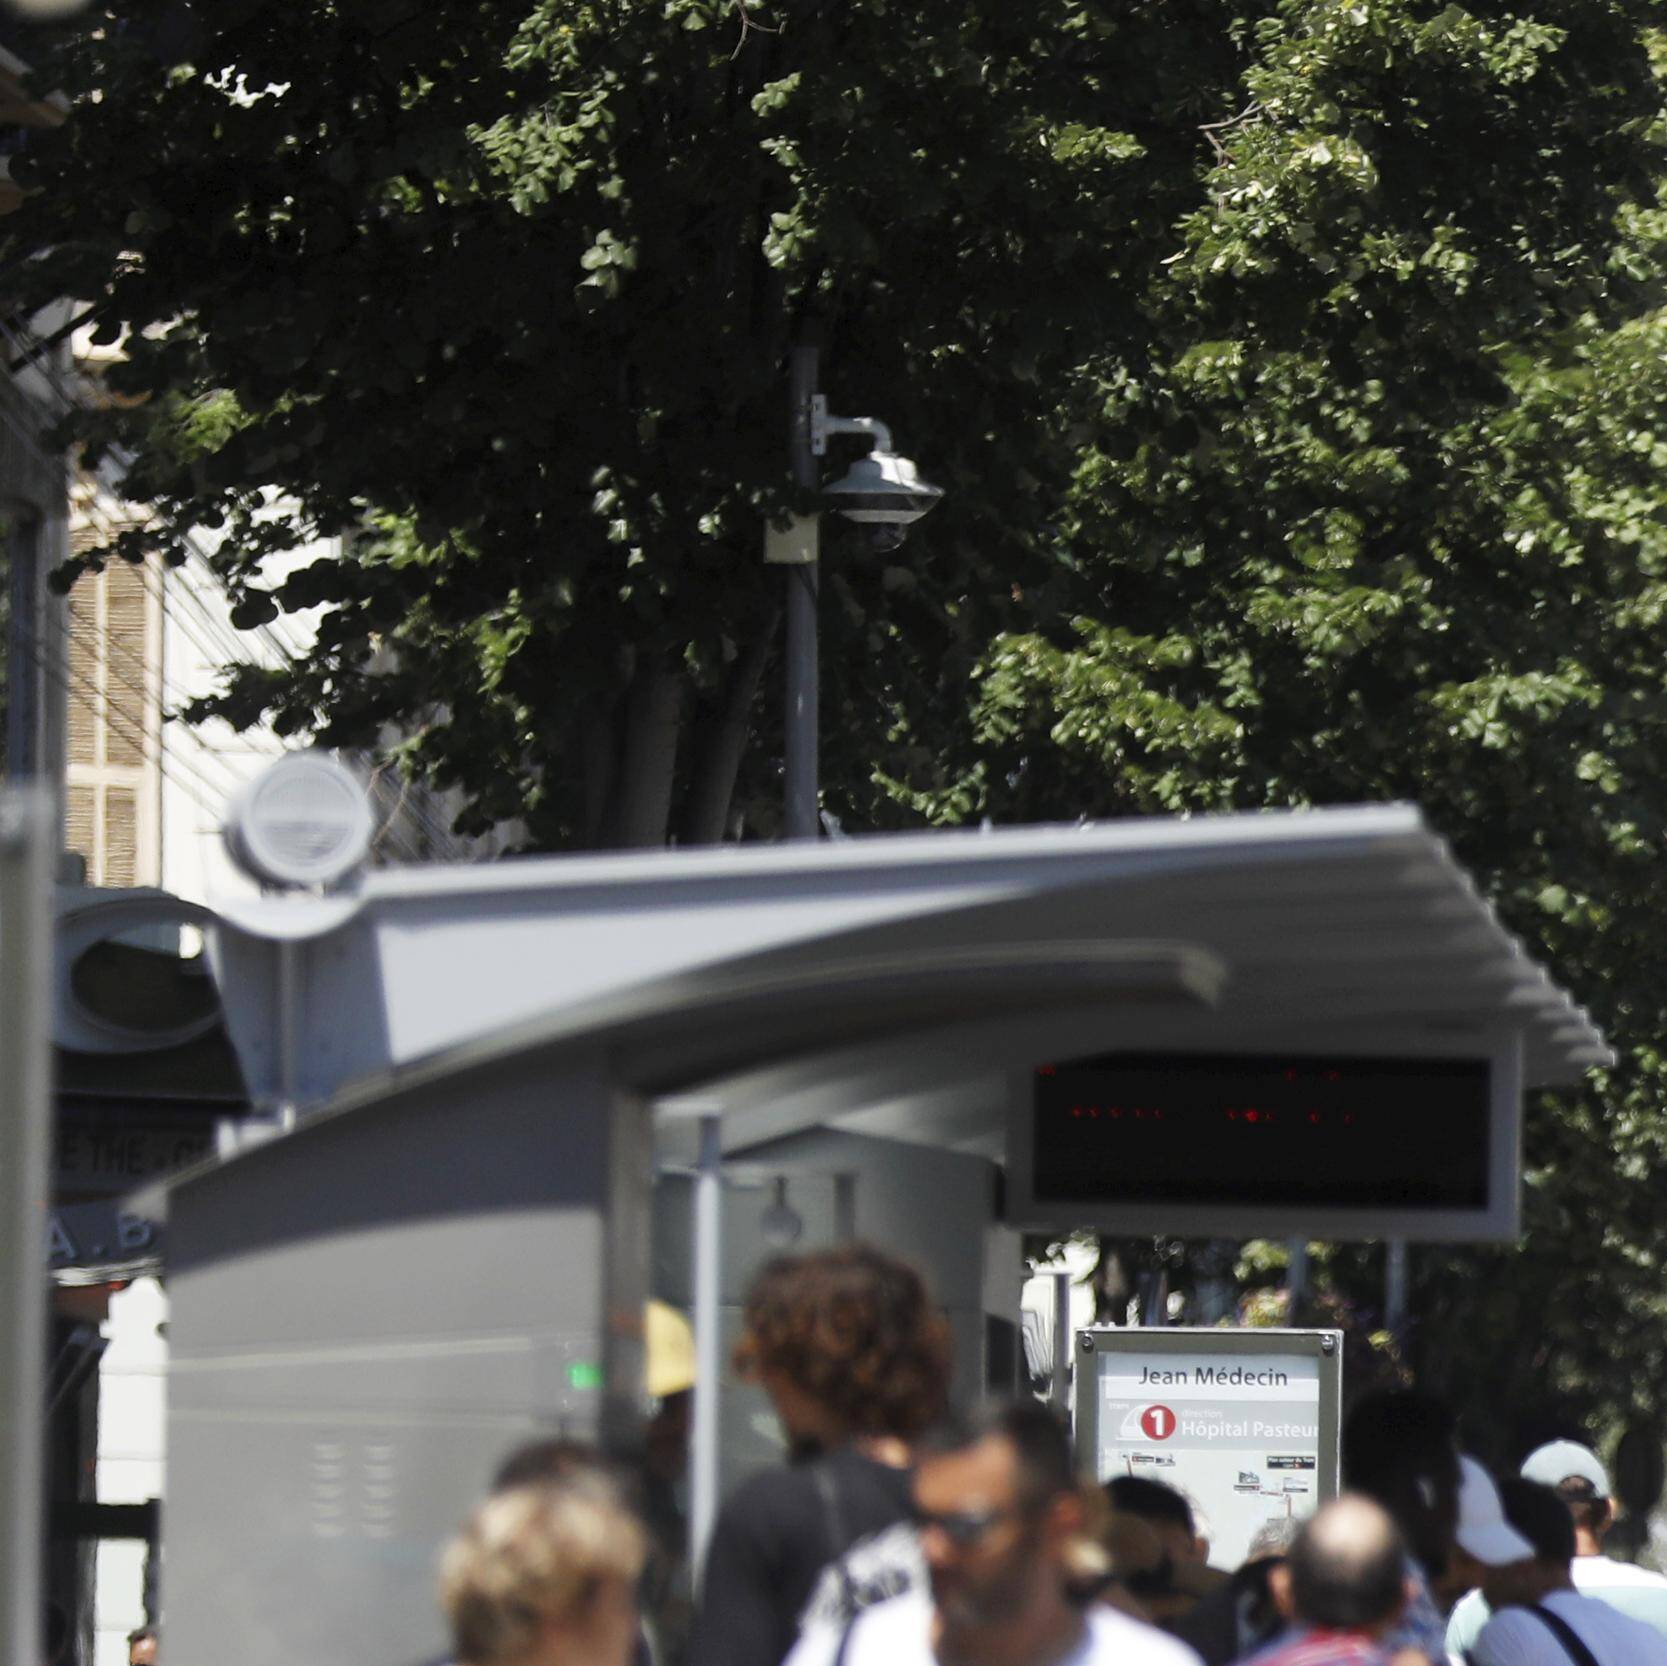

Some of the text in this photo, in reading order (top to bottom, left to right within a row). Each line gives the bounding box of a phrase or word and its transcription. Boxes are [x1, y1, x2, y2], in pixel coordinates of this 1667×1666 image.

[1138, 1366, 1288, 1386] Jean Médecin
[1149, 1409, 1165, 1436] 1
[1181, 1419, 1318, 1440] Hôpital Pasteur
